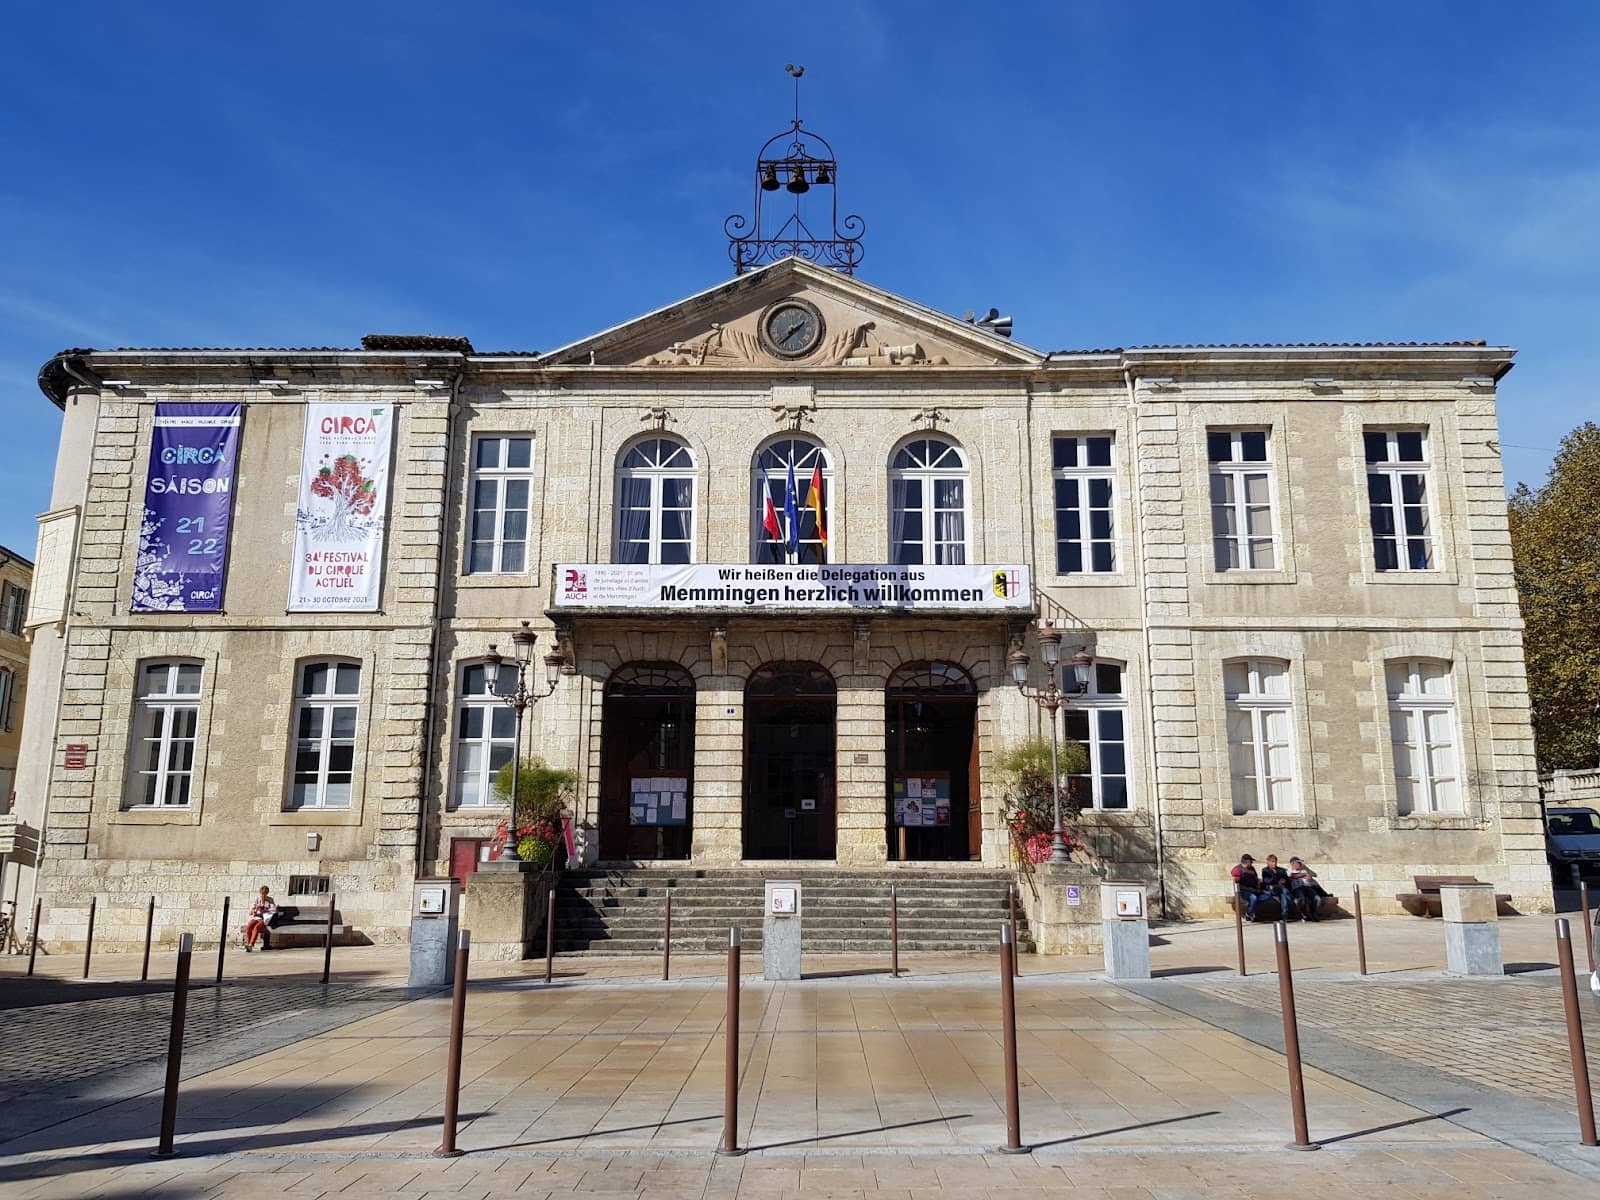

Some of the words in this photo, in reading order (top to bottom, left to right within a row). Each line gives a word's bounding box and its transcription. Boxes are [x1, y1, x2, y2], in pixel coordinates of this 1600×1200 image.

[321, 414, 376, 434] CIRCA
[150, 477, 229, 494] SAISON
[176, 517, 205, 533] 21
[188, 538, 217, 554] 22
[308, 565, 322, 576] DU
[326, 565, 364, 577] CIRQUE
[719, 569, 741, 580] Wir
[745, 569, 793, 580] heißen
[796, 569, 818, 581] die
[822, 569, 897, 583] Delegation
[901, 572, 925, 581] aus
[316, 577, 354, 588] ACTUEL
[190, 590, 215, 600] CIRCA
[660, 585, 779, 605] Memmingen
[784, 585, 859, 601] herzlich
[863, 585, 983, 602] willkommen
